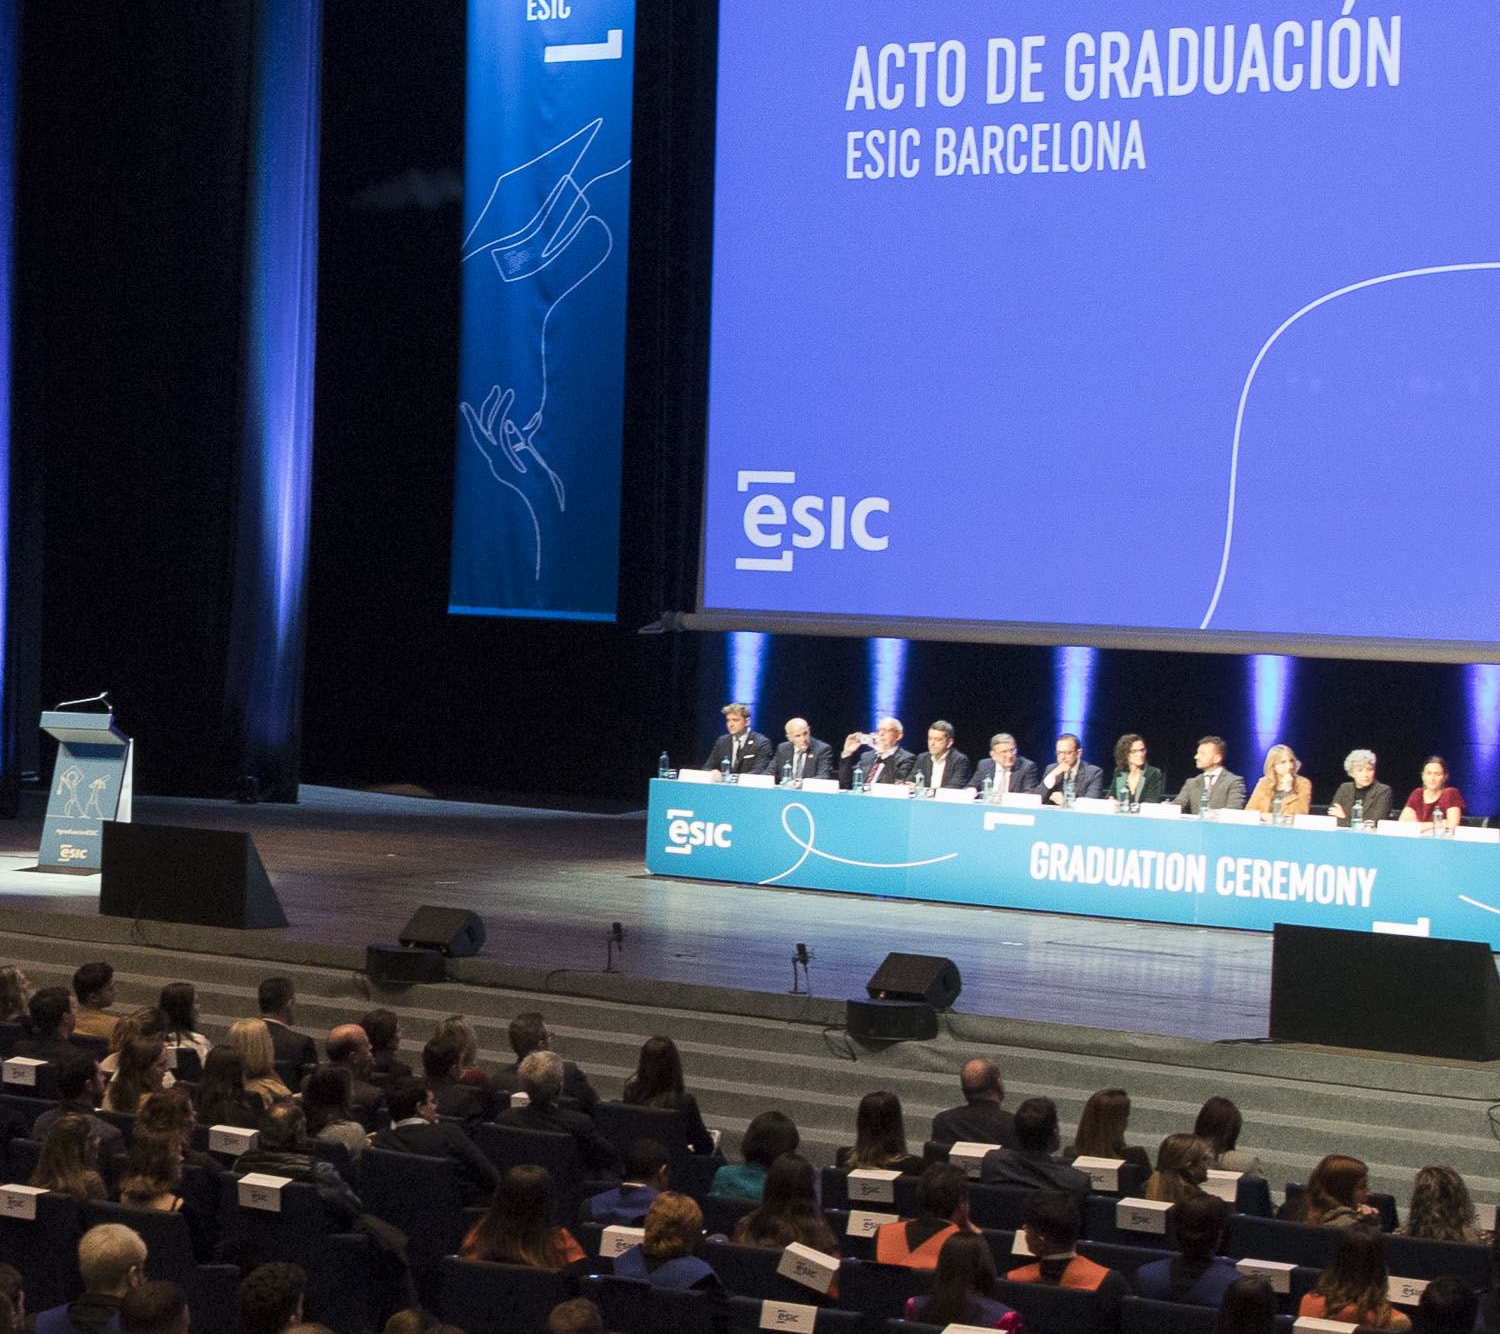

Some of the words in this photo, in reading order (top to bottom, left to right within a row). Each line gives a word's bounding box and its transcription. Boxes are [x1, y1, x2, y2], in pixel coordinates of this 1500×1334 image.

[844, 41, 968, 112] ACTO
[986, 35, 1047, 105] DE
[846, 129, 921, 180] ESIC
[934, 118, 1147, 177] BARCELONA
[740, 491, 891, 555] esic
[667, 817, 732, 849] esic
[1029, 841, 1206, 894] GRADUATION
[1215, 855, 1378, 908] CEREMONY
